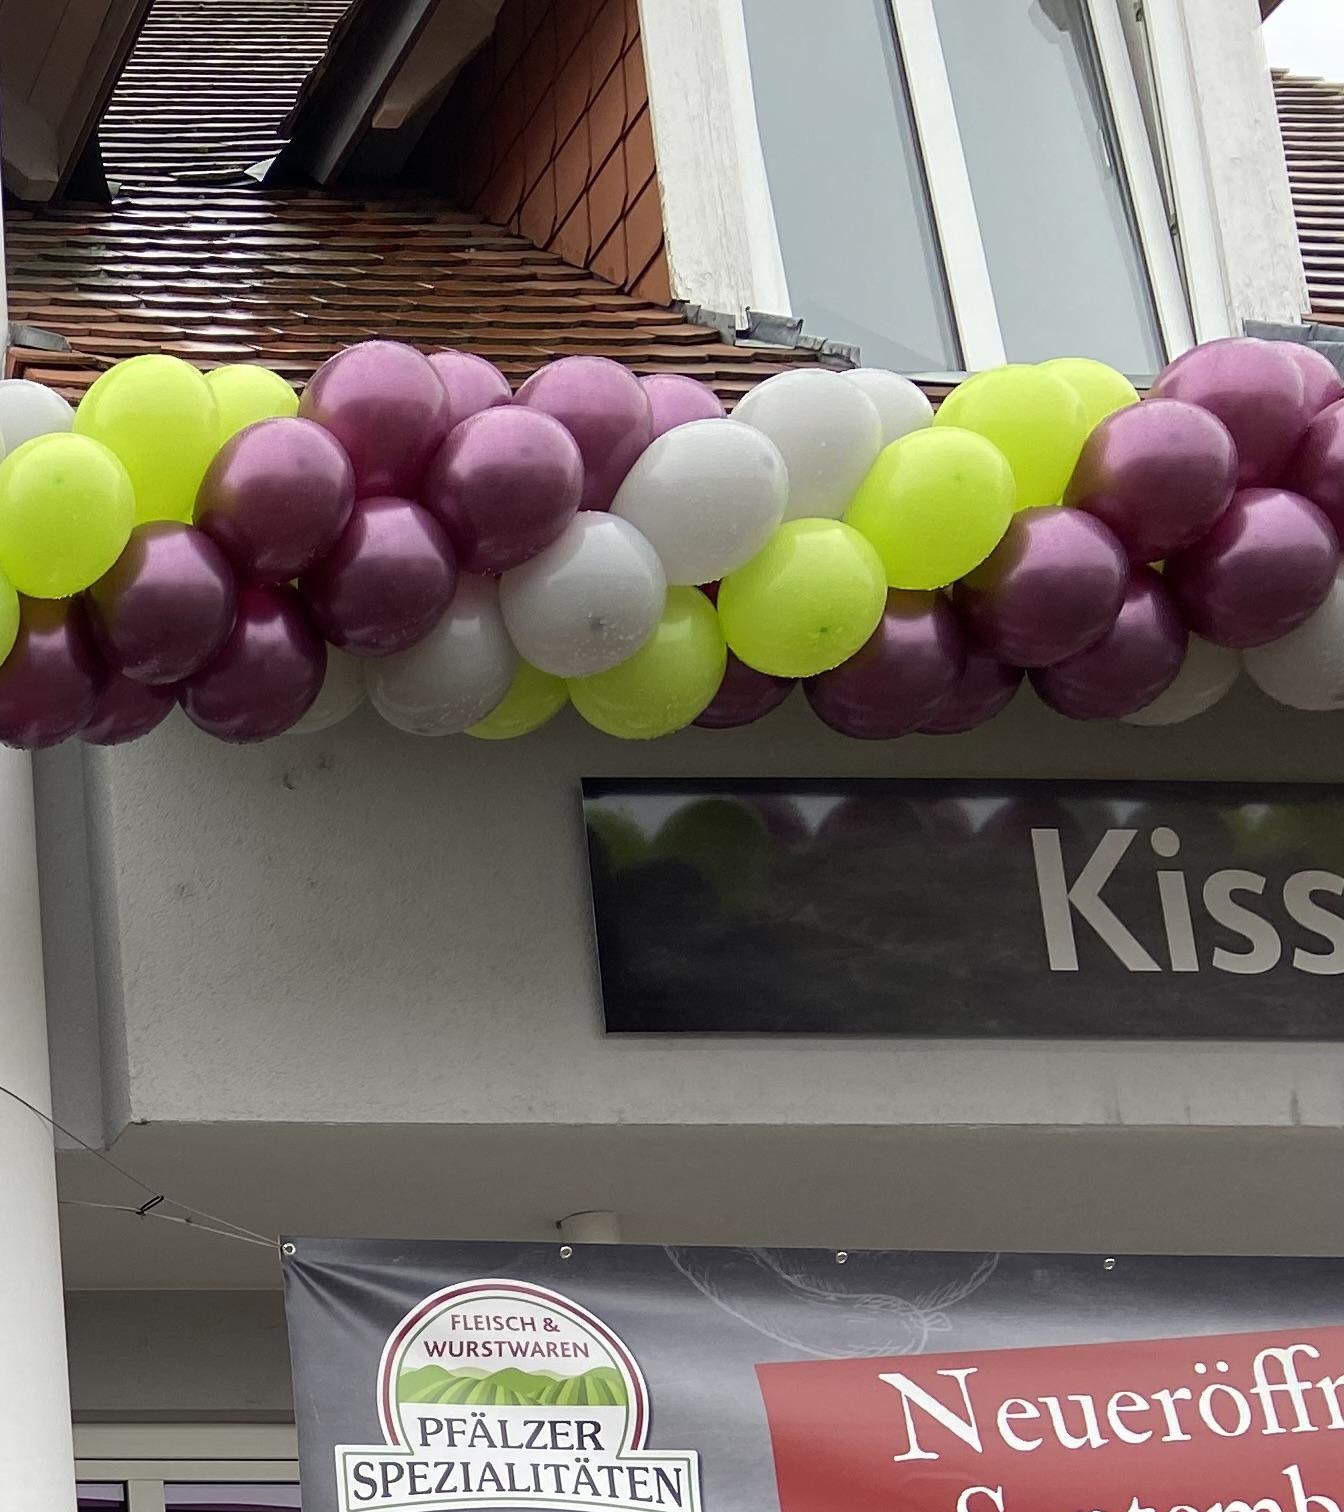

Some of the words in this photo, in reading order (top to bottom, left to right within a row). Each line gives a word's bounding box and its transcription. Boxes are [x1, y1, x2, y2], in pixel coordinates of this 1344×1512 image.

[1031, 826, 1344, 976] Kiss
[450, 1313, 536, 1333] FLEISCH
[542, 1316, 561, 1333] &
[423, 1340, 590, 1359] WURSTWAREN
[417, 1411, 605, 1451] PFÄLZER
[352, 1457, 683, 1508] SPEZIALITÄTEN
